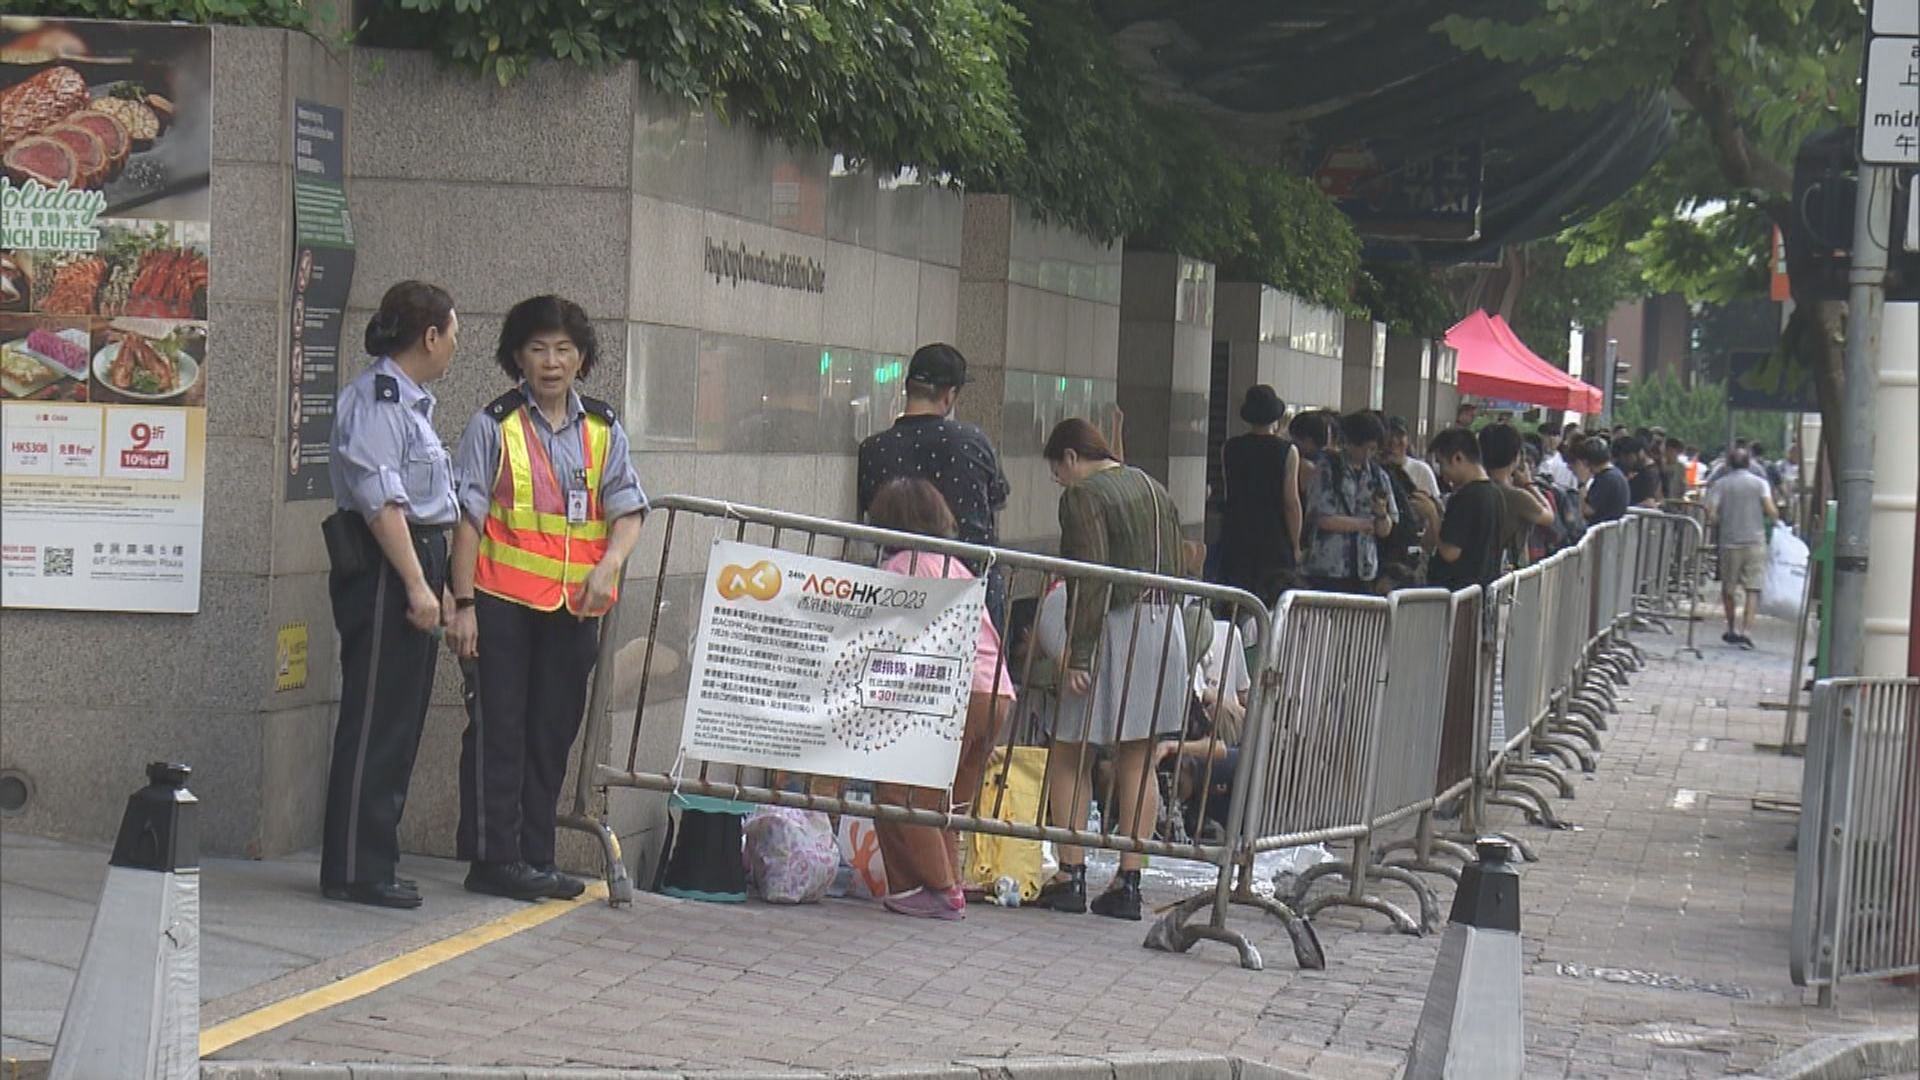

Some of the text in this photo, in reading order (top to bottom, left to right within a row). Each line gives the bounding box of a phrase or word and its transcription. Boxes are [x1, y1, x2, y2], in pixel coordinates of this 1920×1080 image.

[1, 178, 107, 225] oliday
[1403, 187, 1470, 213] TAXI
[39, 230, 97, 248] BUFFET
[149, 453, 167, 467] off
[788, 570, 806, 581] 24th
